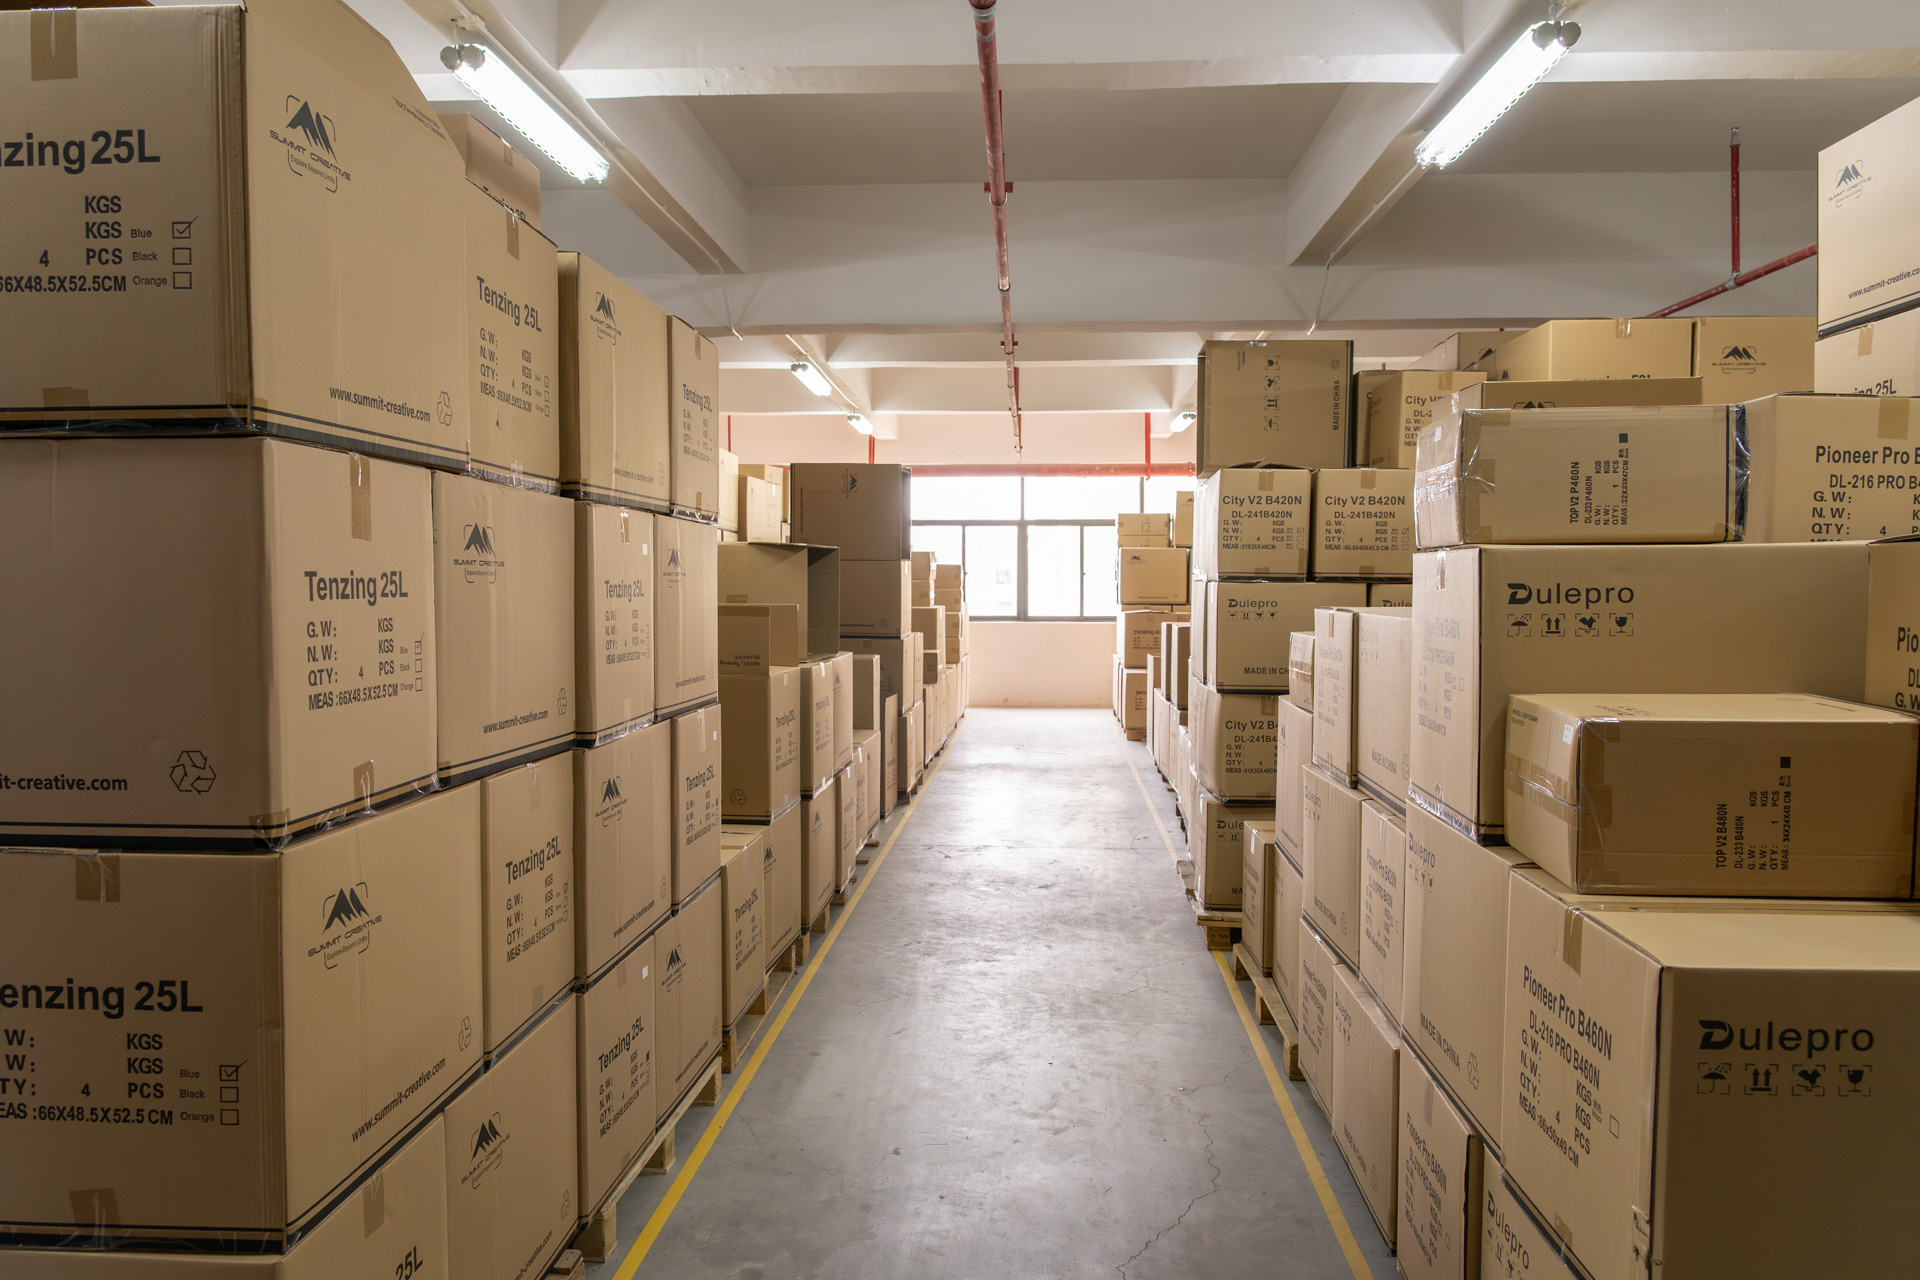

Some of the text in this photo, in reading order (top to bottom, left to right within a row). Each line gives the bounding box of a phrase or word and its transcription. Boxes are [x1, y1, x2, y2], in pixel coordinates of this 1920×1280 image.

[0, 129, 161, 174] zing 25L
[270, 129, 351, 181] SUMMIT CREATIVE
[290, 155, 307, 169] Explore
[307, 163, 324, 178] Beyond
[85, 195, 122, 213] KGS
[1828, 190, 1846, 202] SUMMIT
[85, 221, 152, 239] KGS Blue
[39, 248, 158, 267] 4 PCS Black
[133, 276, 167, 287] Orange
[476, 275, 542, 332] Tenzing 25L
[522, 349, 531, 363] KGS
[522, 365, 532, 379] KGS
[522, 382, 532, 396] PCS
[682, 383, 703, 411] Tenzing
[329, 387, 431, 422] www.summit-creative.com
[1406, 396, 1426, 406] City
[1816, 446, 1878, 464] Pioneer
[1882, 446, 1910, 464] Pro
[1830, 474, 1905, 489] DL-216 PRO
[1223, 496, 1302, 506] City V2 B420N
[1325, 496, 1406, 507] City V2 B420N
[1570, 462, 1580, 524] TOP V2 P460N
[1232, 510, 1292, 518] DL-241B420N
[1334, 511, 1396, 519] DL-241B420N
[1880, 526, 1886, 536] 4
[304, 570, 408, 606] Tenzing 25L
[604, 579, 644, 602] Tenzing 25L
[1507, 582, 1634, 610] Dulepro
[1228, 598, 1278, 610] Dulepro
[378, 617, 393, 633] KGS
[378, 638, 394, 654] KGS
[359, 666, 364, 678] 4
[379, 660, 394, 676] PCS
[483, 710, 548, 734] www.summit-creative.com
[1226, 720, 1264, 732] City V2
[1372, 749, 1397, 774] MADE CHINA
[686, 771, 706, 792] Tenzing
[1304, 786, 1321, 808] Dulepro
[1749, 790, 1757, 806] KGS
[1772, 790, 1780, 806] PCS
[1716, 804, 1728, 869] TOP V2 B480N
[1734, 816, 1744, 868] DL-233 B480N
[506, 836, 561, 884] Tenzing 25L
[1408, 832, 1436, 868] Dulepro
[544, 874, 554, 888] KGS
[544, 889, 554, 904] KGS
[544, 905, 554, 920] PCS
[735, 896, 751, 922] Tenzing
[1314, 896, 1336, 925] MADE CHINA
[308, 915, 382, 957] SUMMIT CREATIVE
[327, 949, 342, 960] Explore
[0, 978, 203, 1019] enzing 25L
[1335, 990, 1352, 1028] Dulepro
[1524, 965, 1612, 1061] Pioneer Pro B460N
[126, 1033, 163, 1050] KGS
[598, 1016, 644, 1074] Tenzing 25L
[1420, 1012, 1460, 1070] MADE IN CHINA
[1529, 1010, 1600, 1090] DL-216 PRO B460N
[1699, 1020, 1874, 1058] Dulepro
[127, 1058, 200, 1078] KGS Blue
[81, 1082, 205, 1099] 4 PCS Black
[352, 1057, 446, 1143] www.summit-creative.com
[1576, 1080, 1592, 1106] KGS
[180, 1112, 214, 1122] Orange
[1576, 1102, 1592, 1130] KGS
[1406, 1112, 1422, 1150] Pioneer
[1422, 1138, 1430, 1166] Pro
[1556, 1110, 1560, 1124] 4
[1574, 1126, 1590, 1155] PCS
[461, 1160, 484, 1184] SUMMIT
[485, 1133, 510, 1162] CREATIVE
[1568, 1150, 1579, 1168] CM
[1487, 1189, 1530, 1270] Dulepro
[1429, 1238, 1438, 1258] PCS
[395, 1245, 423, 1280] 25L
